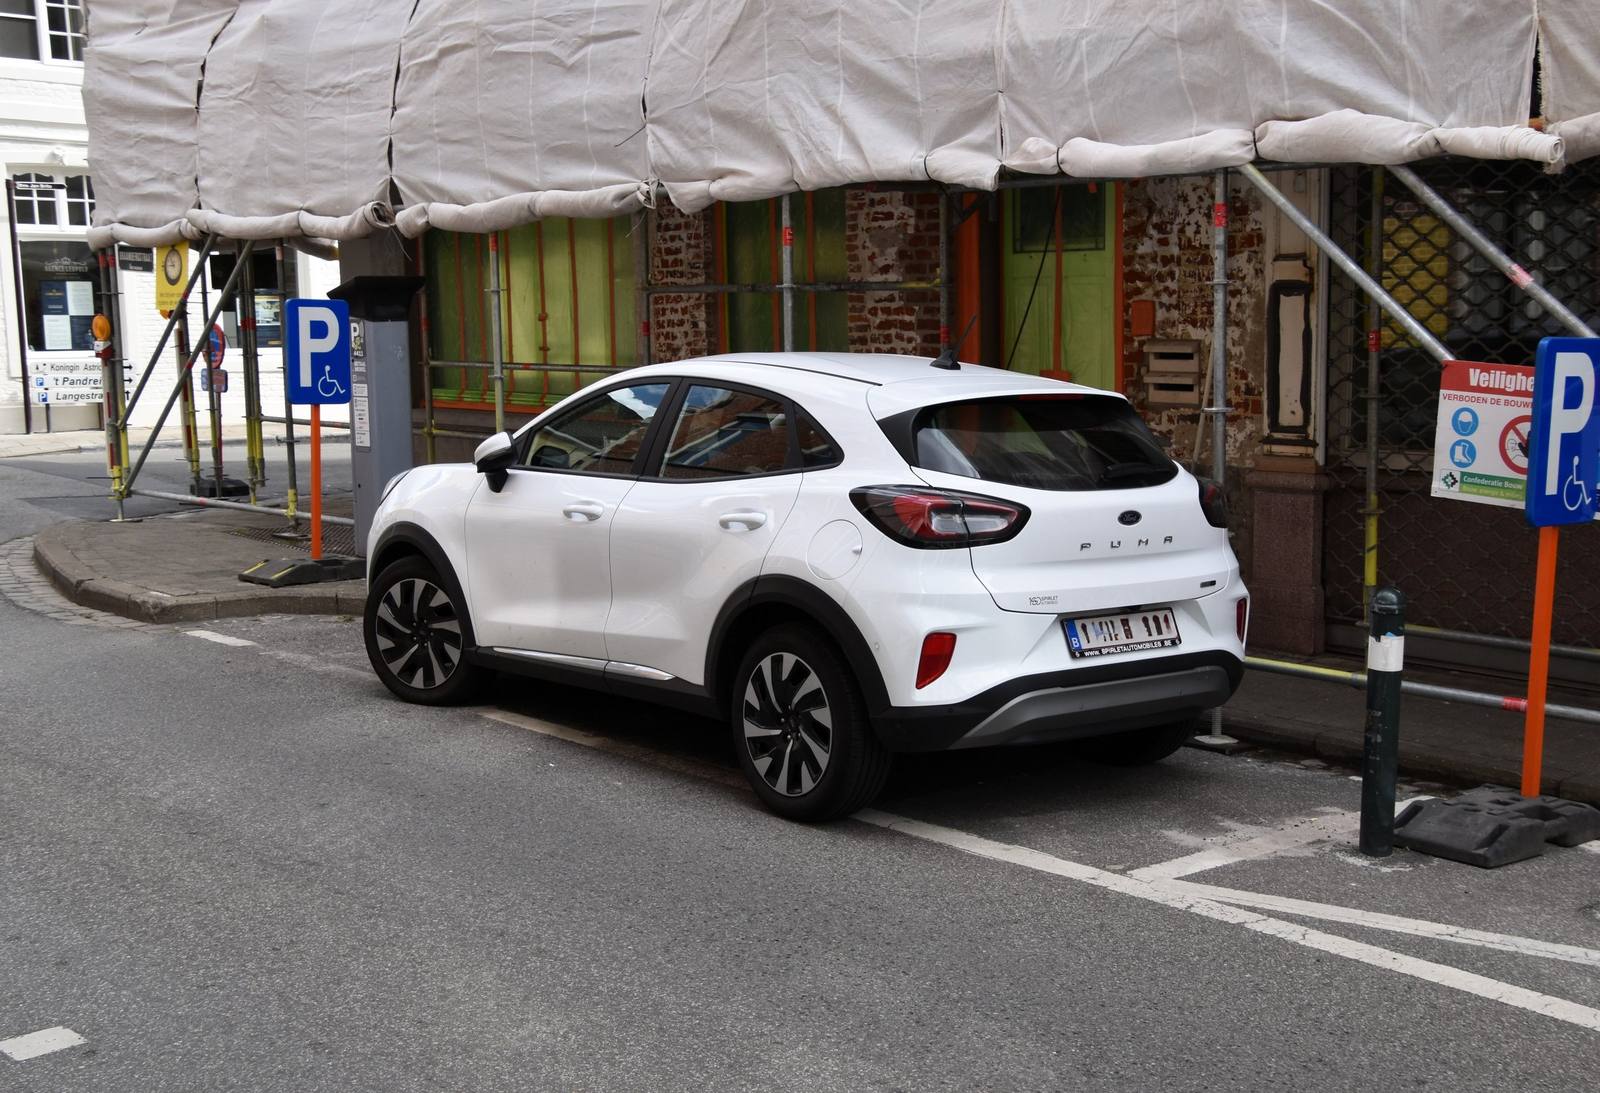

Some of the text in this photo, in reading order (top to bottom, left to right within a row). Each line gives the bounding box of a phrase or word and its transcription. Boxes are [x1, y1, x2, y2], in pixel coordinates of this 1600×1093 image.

[298, 307, 340, 388] P
[50, 363, 80, 373] Koningin
[1442, 393, 1488, 405] VERBODEN
[1490, 398, 1502, 406] DE
[1545, 352, 1595, 496] P
[1463, 475, 1523, 490] Confederatie Bouw
[1072, 638, 1080, 648] B
